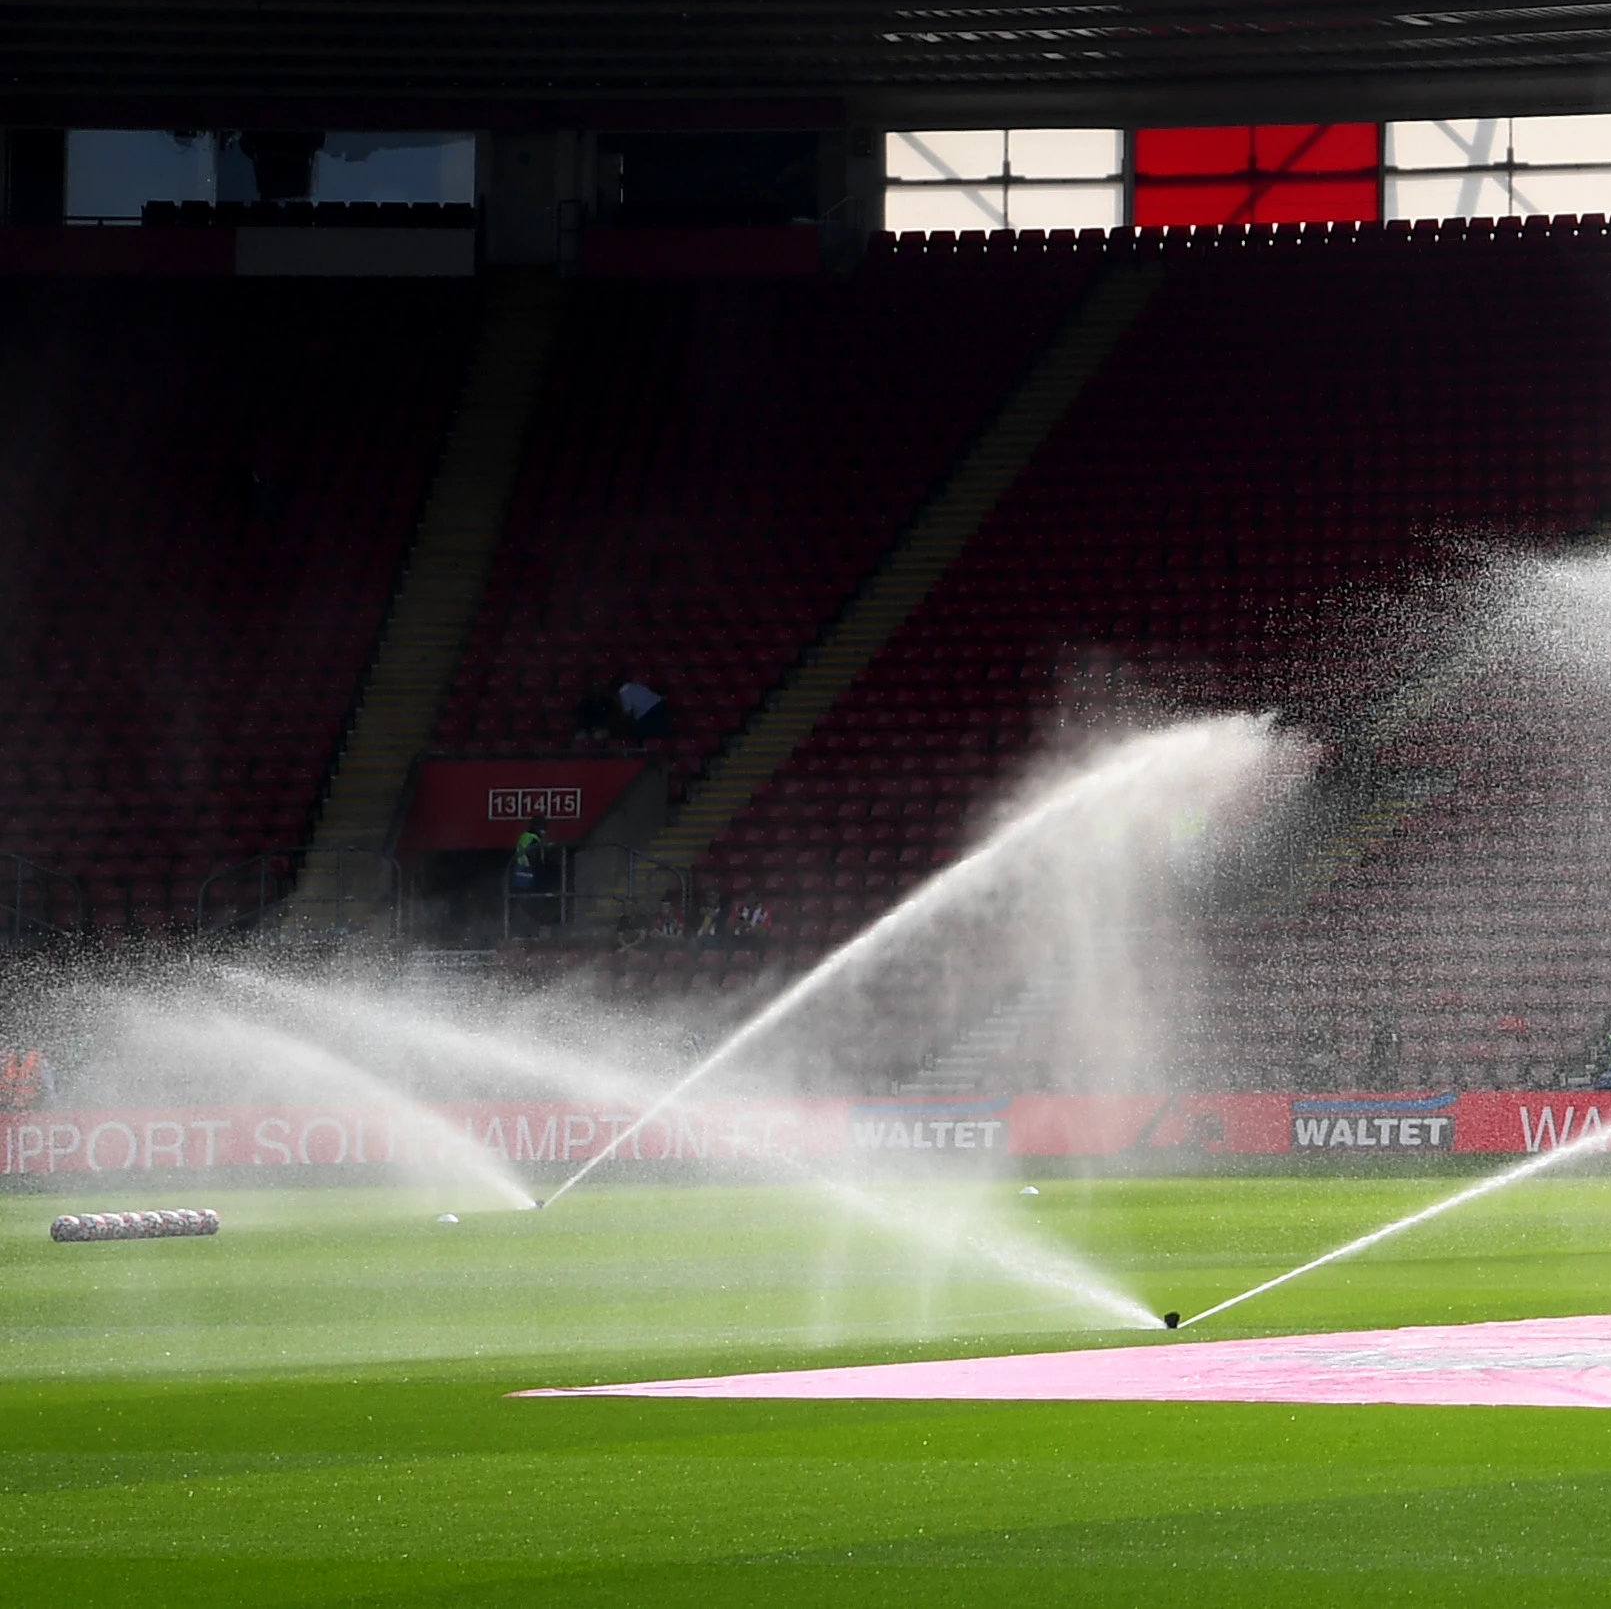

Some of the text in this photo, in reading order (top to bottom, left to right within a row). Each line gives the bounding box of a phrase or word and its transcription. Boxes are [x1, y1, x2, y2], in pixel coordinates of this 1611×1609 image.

[493, 794, 576, 814] 13 14 15
[253, 1112, 711, 1165] SOUAMPTON
[851, 1120, 1002, 1149] WALTET
[1295, 1117, 1448, 1147] WALTET
